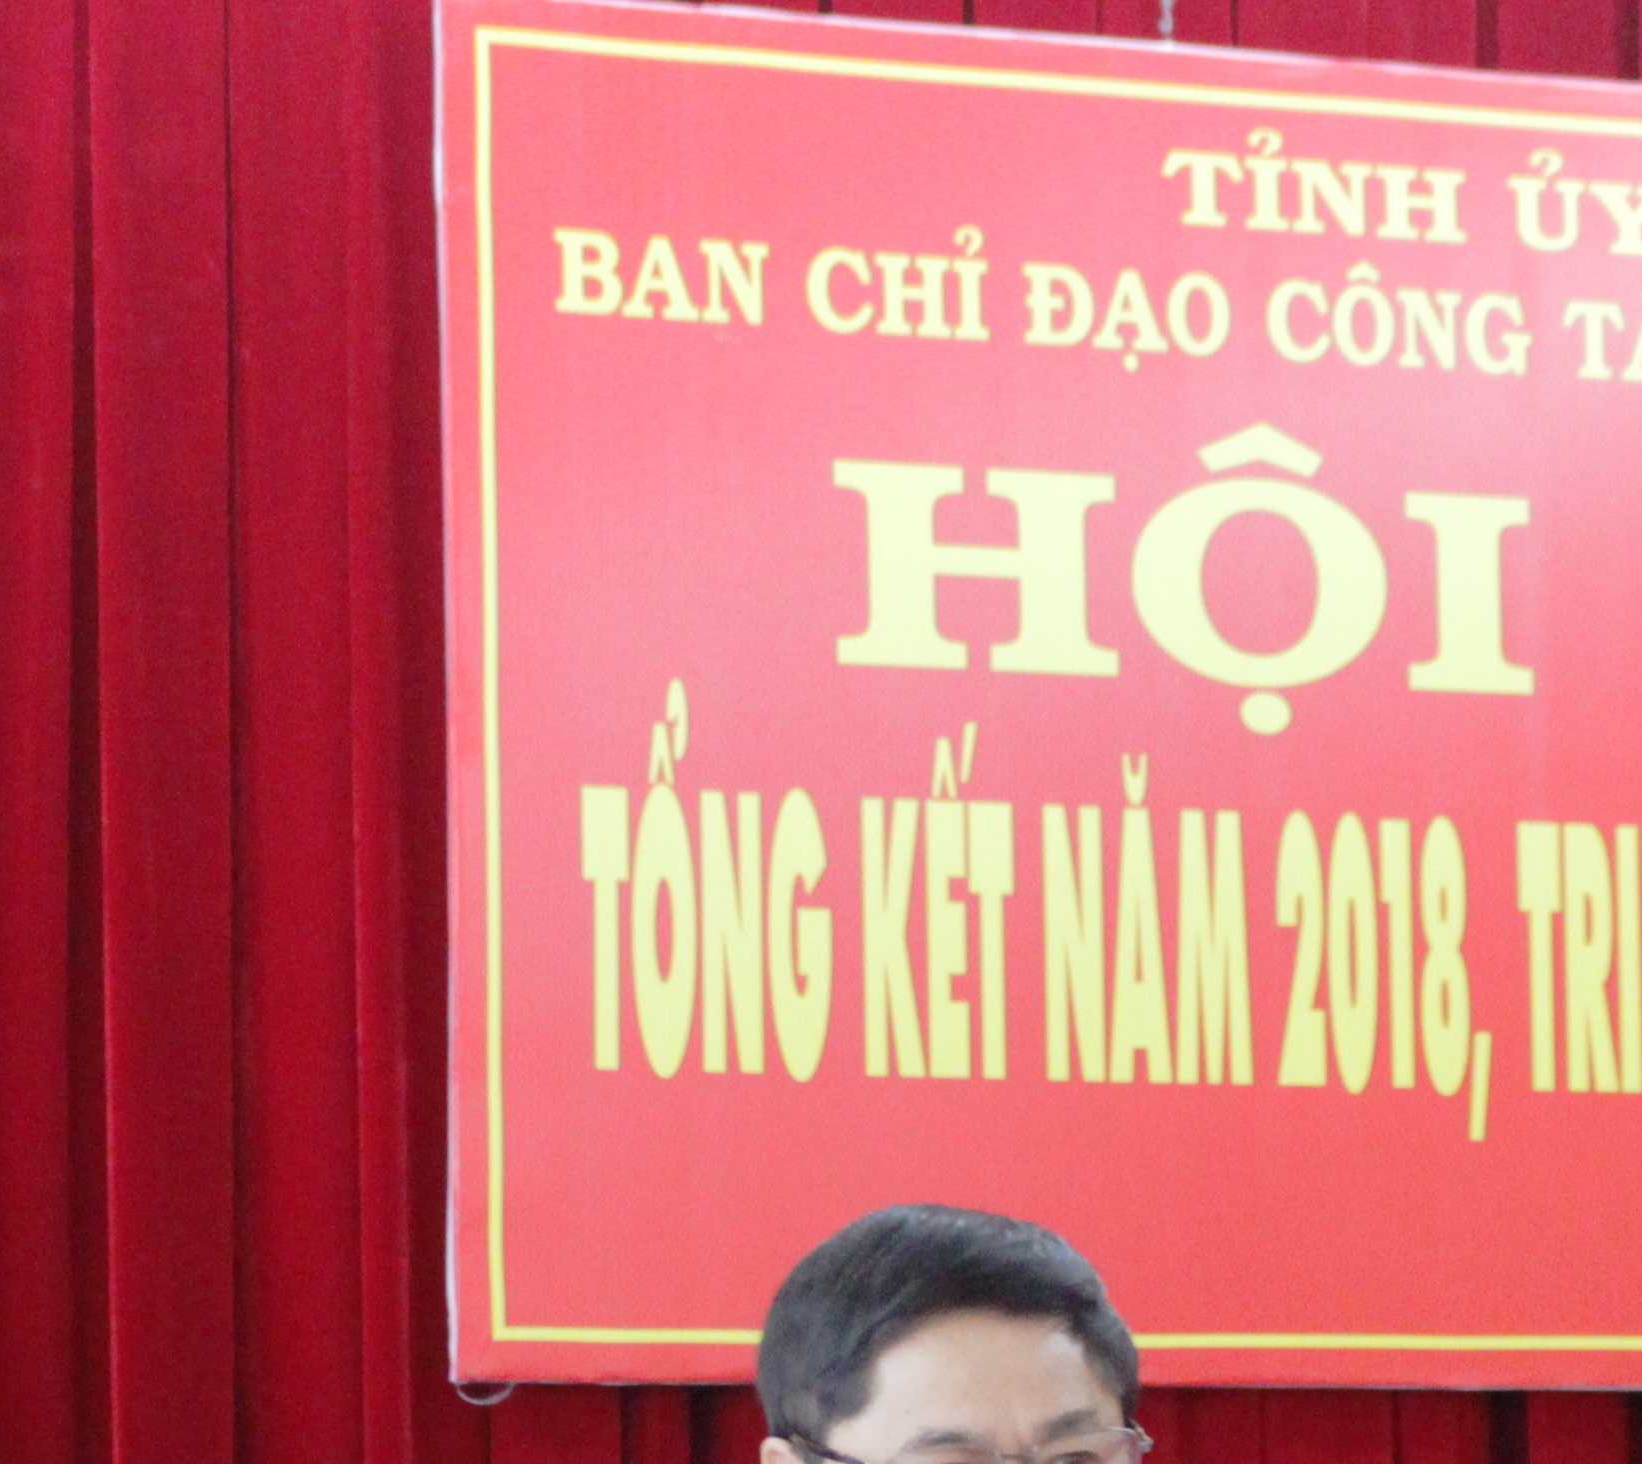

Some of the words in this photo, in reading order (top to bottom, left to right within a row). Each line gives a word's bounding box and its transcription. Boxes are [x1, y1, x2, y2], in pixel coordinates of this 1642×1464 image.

[554, 228, 769, 326] BAN
[807, 226, 989, 342] CHỈ
[1023, 261, 1230, 372] ĐẠO
[1267, 260, 1531, 376] CÔNG
[1163, 128, 1466, 244] TỈNH
[832, 422, 1535, 735] HỘI
[581, 678, 833, 1083] TỔNG
[860, 721, 1014, 1081] KẾT
[1042, 752, 1254, 1085] NĂM
[1275, 810, 1492, 1142] 2018,
